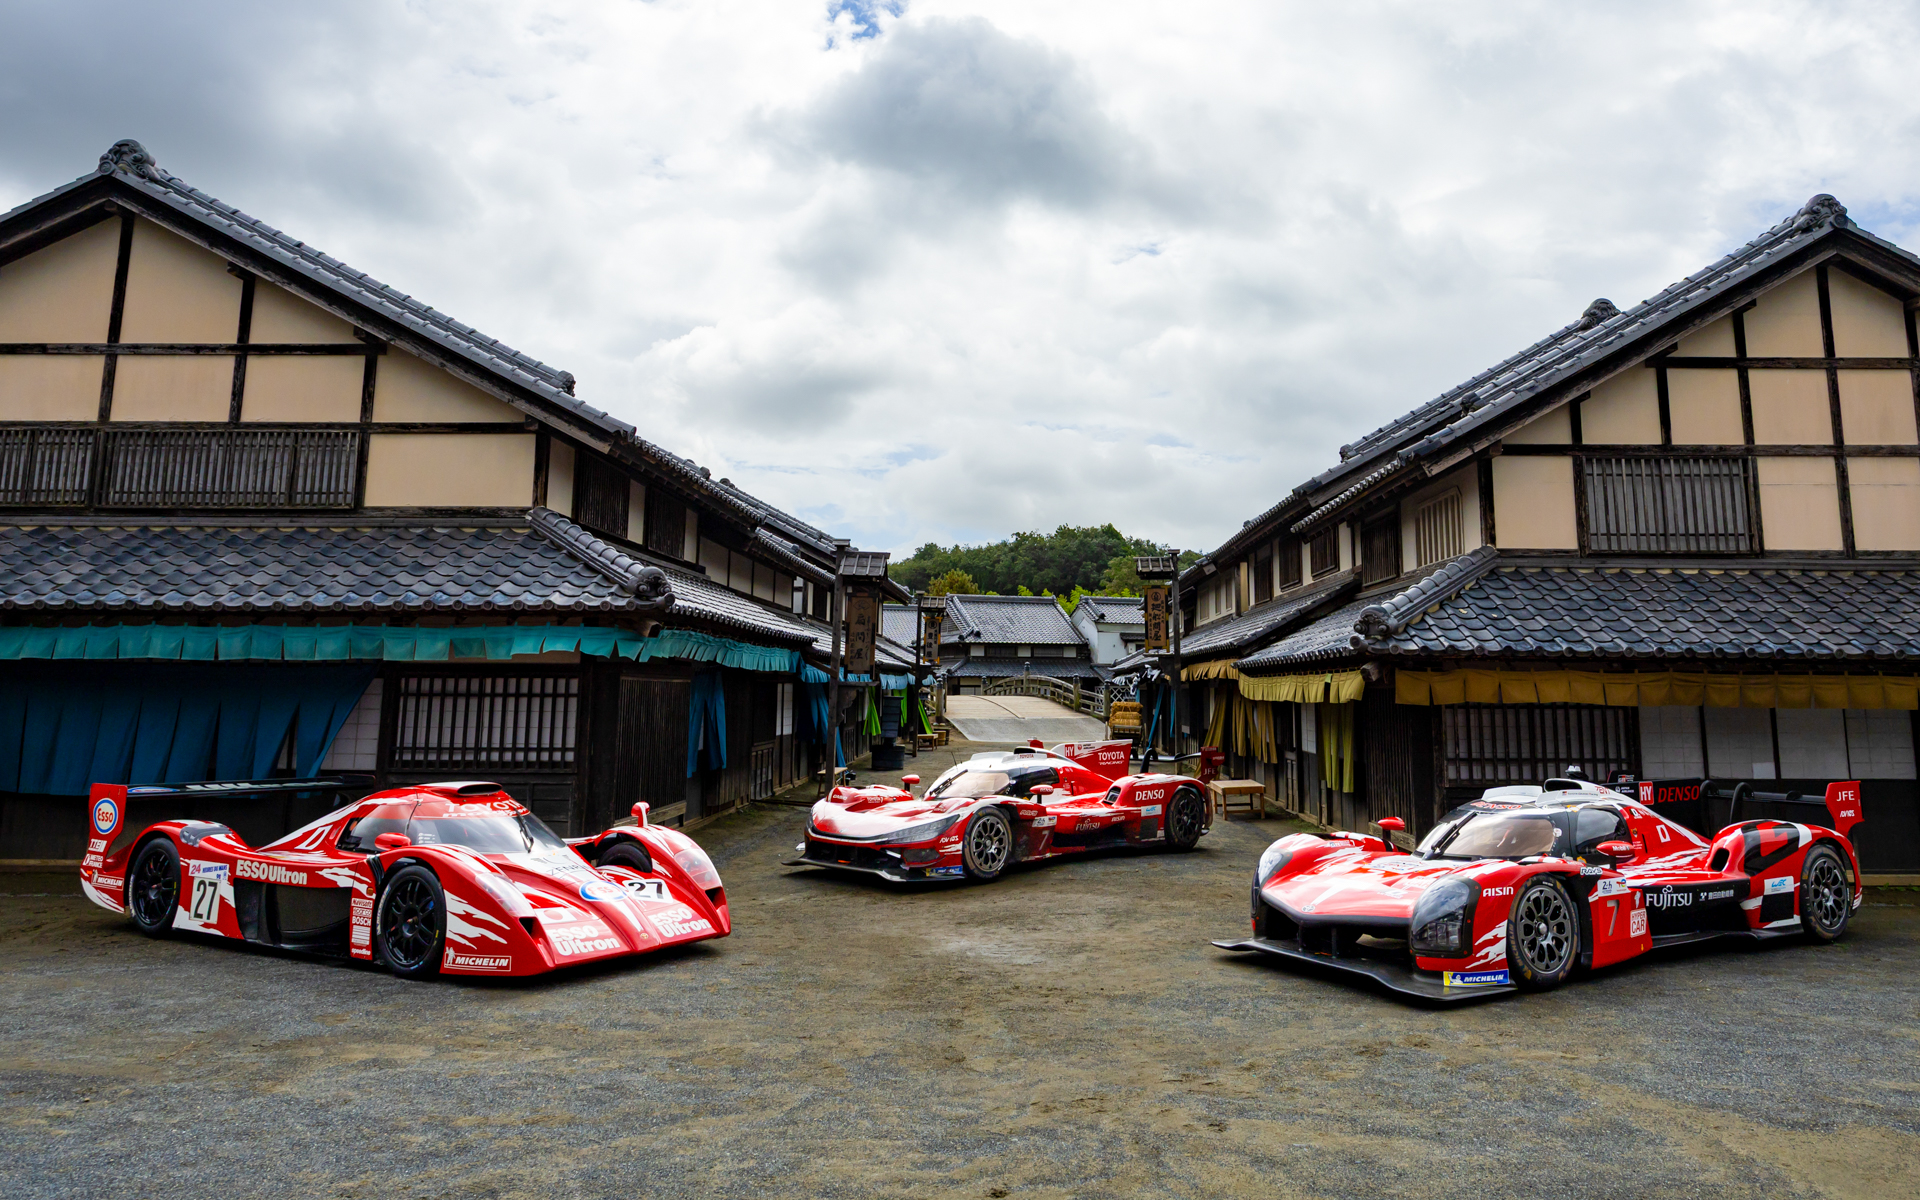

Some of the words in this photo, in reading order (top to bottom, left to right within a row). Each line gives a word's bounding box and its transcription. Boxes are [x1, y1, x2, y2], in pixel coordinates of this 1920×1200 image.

[1065, 746, 1074, 757] HY
[1098, 751, 1125, 761] TOYOTA
[1203, 767, 1216, 776] JFE
[1135, 789, 1165, 801] DENSO
[1640, 786, 1652, 802] HY
[1658, 785, 1699, 803] DENSO
[1836, 790, 1855, 802] JFE
[445, 799, 522, 812] TOYOTA
[1076, 822, 1100, 831] FUJITSU
[1040, 829, 1050, 850] 7
[190, 864, 201, 875] 24
[97, 877, 123, 887] MICHELIN
[628, 881, 664, 899] 27
[1483, 887, 1514, 897] AISIN
[194, 880, 218, 920] 27
[1646, 893, 1693, 910] FUJITSU
[352, 916, 371, 926] BOSCH
[648, 908, 693, 927] ESSO
[1607, 899, 1620, 936] 7
[1632, 910, 1646, 921] HYPER
[658, 918, 712, 938] Ultron
[1632, 919, 1646, 934] CAR
[547, 925, 598, 942] ESSO
[554, 937, 620, 956] Ultron
[455, 956, 509, 967] MICHELIN
[1463, 974, 1504, 983] MICHELIN
